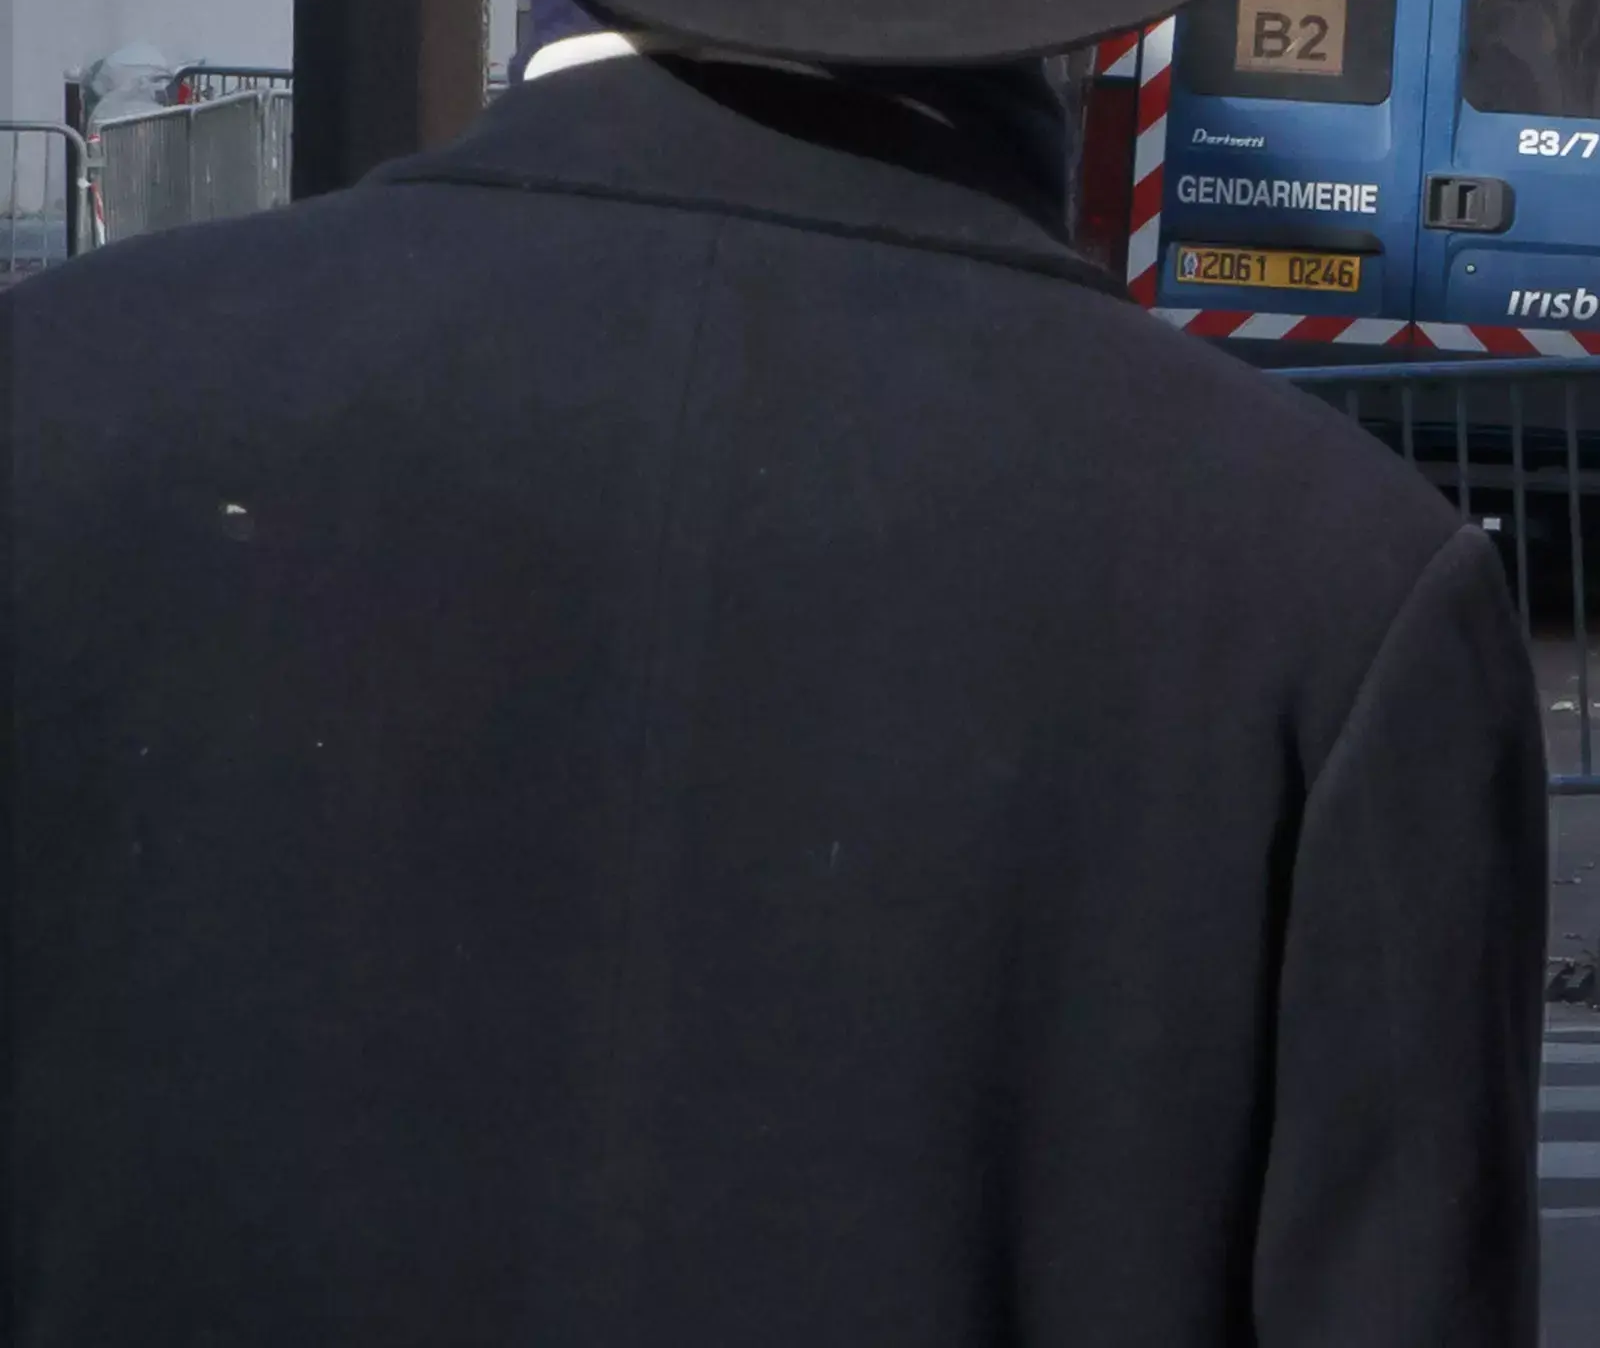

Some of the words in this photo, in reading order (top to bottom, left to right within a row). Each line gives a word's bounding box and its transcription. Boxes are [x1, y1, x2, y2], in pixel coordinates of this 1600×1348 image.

[1253, 11, 1330, 61] B2
[1518, 128, 1600, 158] 23/7
[1177, 175, 1379, 214] GENDARMERIE
[1202, 251, 1267, 282] 2061
[1288, 255, 1355, 288] 0246
